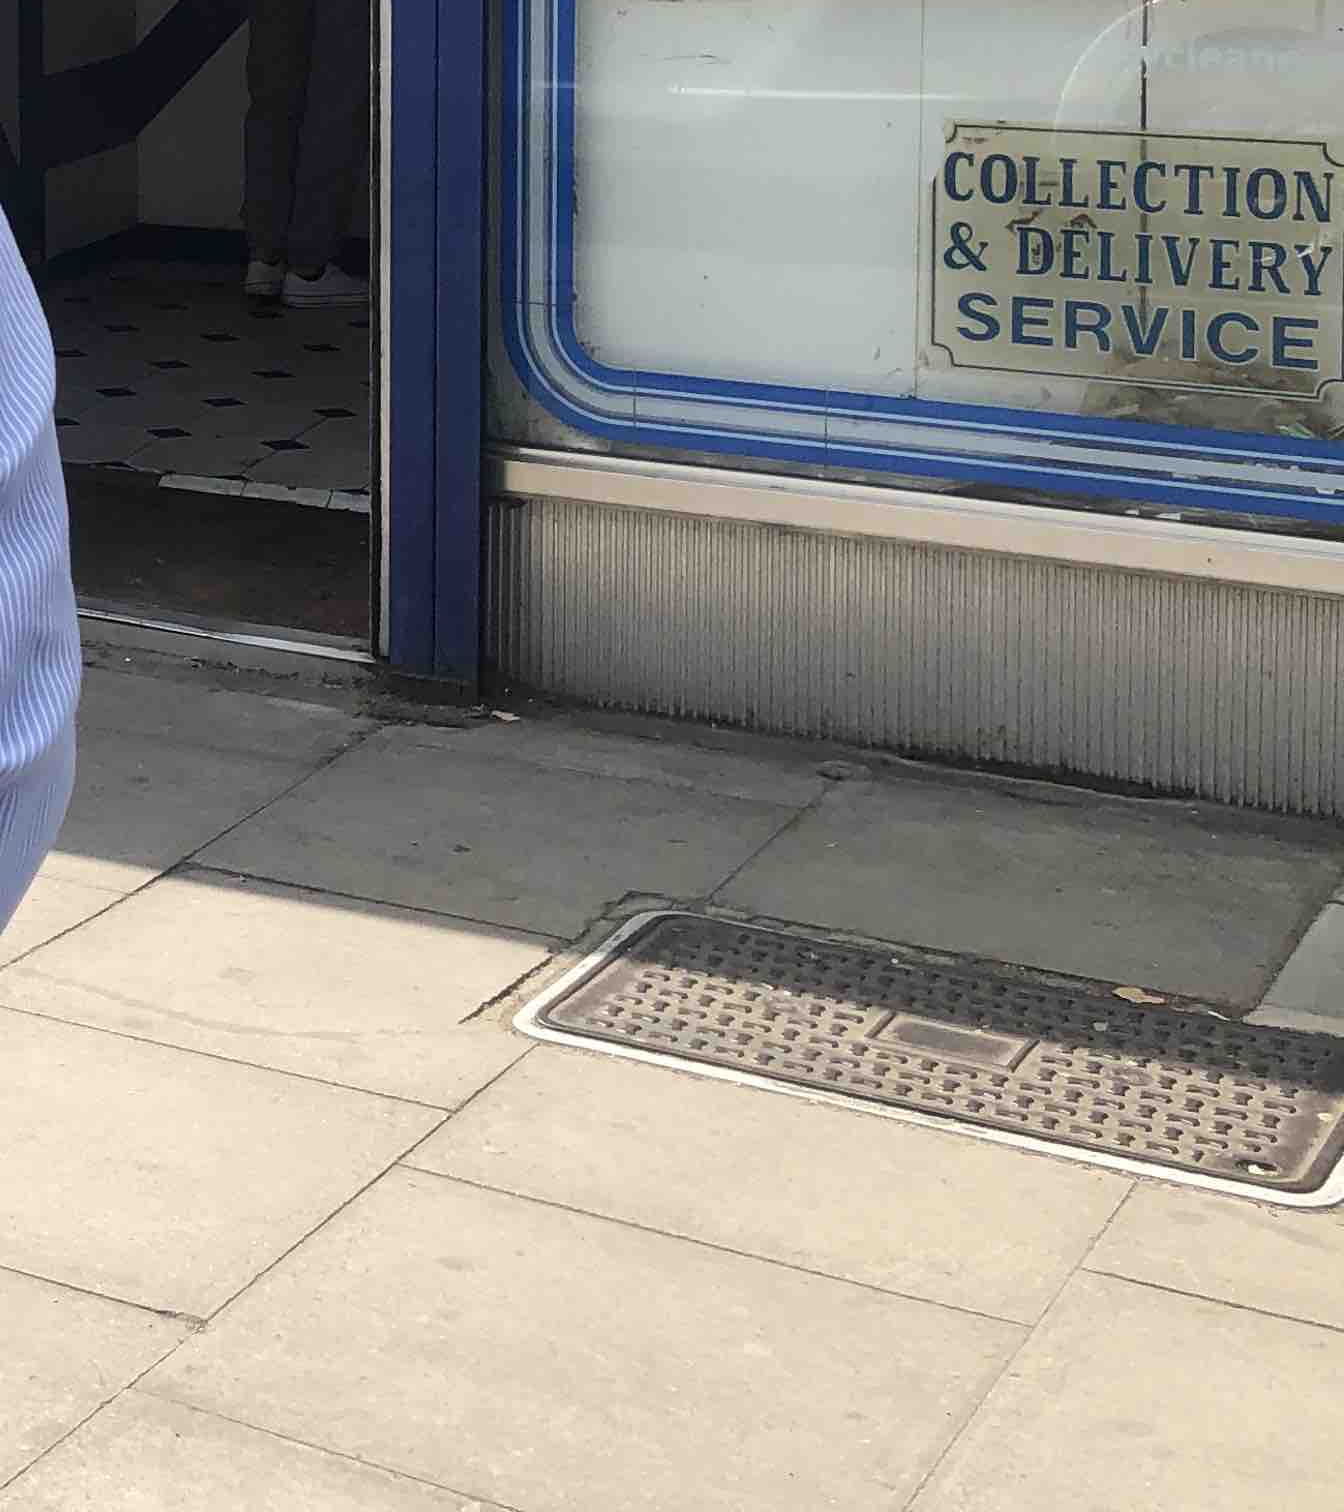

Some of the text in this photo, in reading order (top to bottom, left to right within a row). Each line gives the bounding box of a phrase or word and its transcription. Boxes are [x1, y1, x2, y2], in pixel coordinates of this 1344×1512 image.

[943, 150, 1335, 224] COLLECTION
[943, 221, 1334, 297] & DELIVERY
[955, 292, 1321, 372] SERVICE
